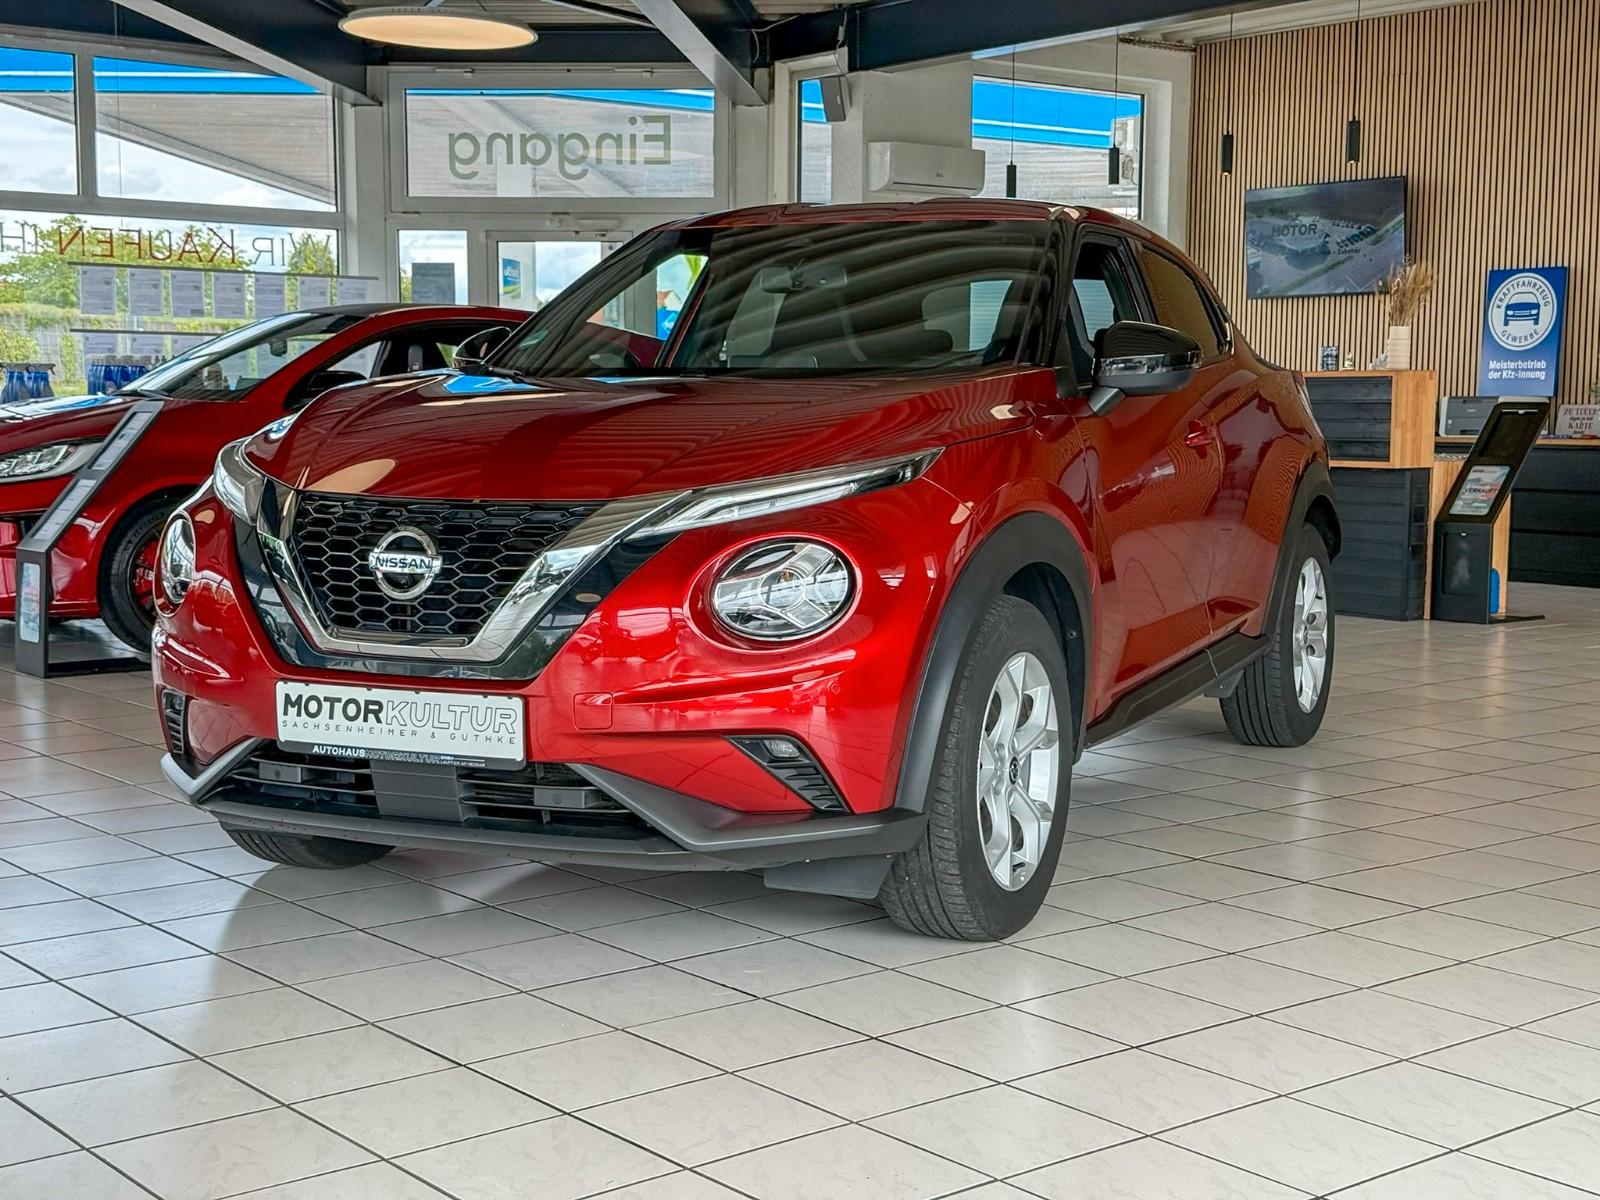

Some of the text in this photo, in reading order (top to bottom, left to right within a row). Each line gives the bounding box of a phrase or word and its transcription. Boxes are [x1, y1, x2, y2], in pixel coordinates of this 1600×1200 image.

[1271, 222, 1318, 238] MOTOR
[1496, 280, 1550, 309] KRAFTFAHRZEUG
[1501, 329, 1539, 344] GEWERBE
[1488, 360, 1547, 370] Meisterbetrieb
[1488, 370, 1546, 380] der Kfz-Innung
[375, 556, 431, 569] NISSAN
[282, 693, 518, 734] MOTORKULTUR
[282, 720, 517, 745] SACHSENHEIMER & GUTHKE
[312, 745, 365, 757] AUTOHAUS
